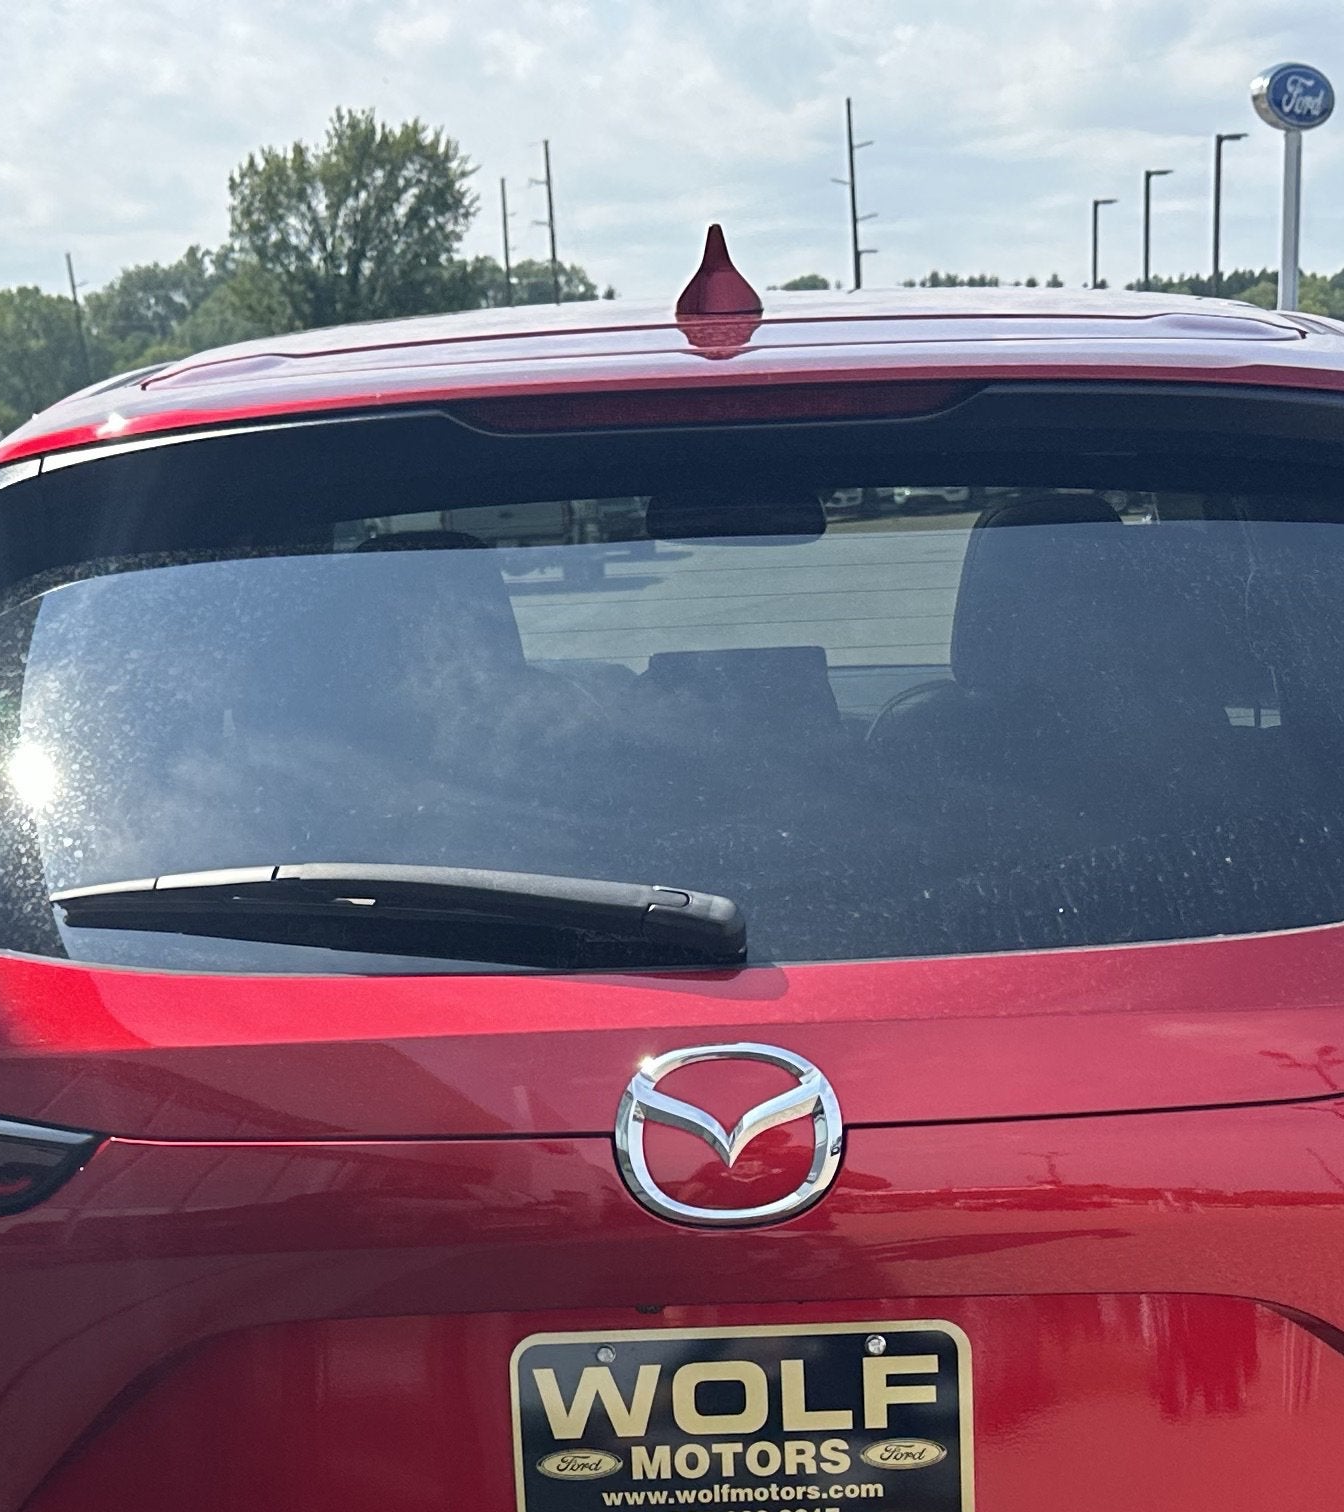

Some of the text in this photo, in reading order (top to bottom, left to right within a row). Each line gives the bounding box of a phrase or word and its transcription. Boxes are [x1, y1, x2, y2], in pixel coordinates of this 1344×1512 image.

[1281, 75, 1324, 115] Ford
[532, 1354, 940, 1440] WOLF
[556, 1454, 603, 1474] Ford
[631, 1438, 851, 1480] MOTORS
[879, 1443, 927, 1464] Ford
[602, 1481, 884, 1507] www.wolfmotors.com
